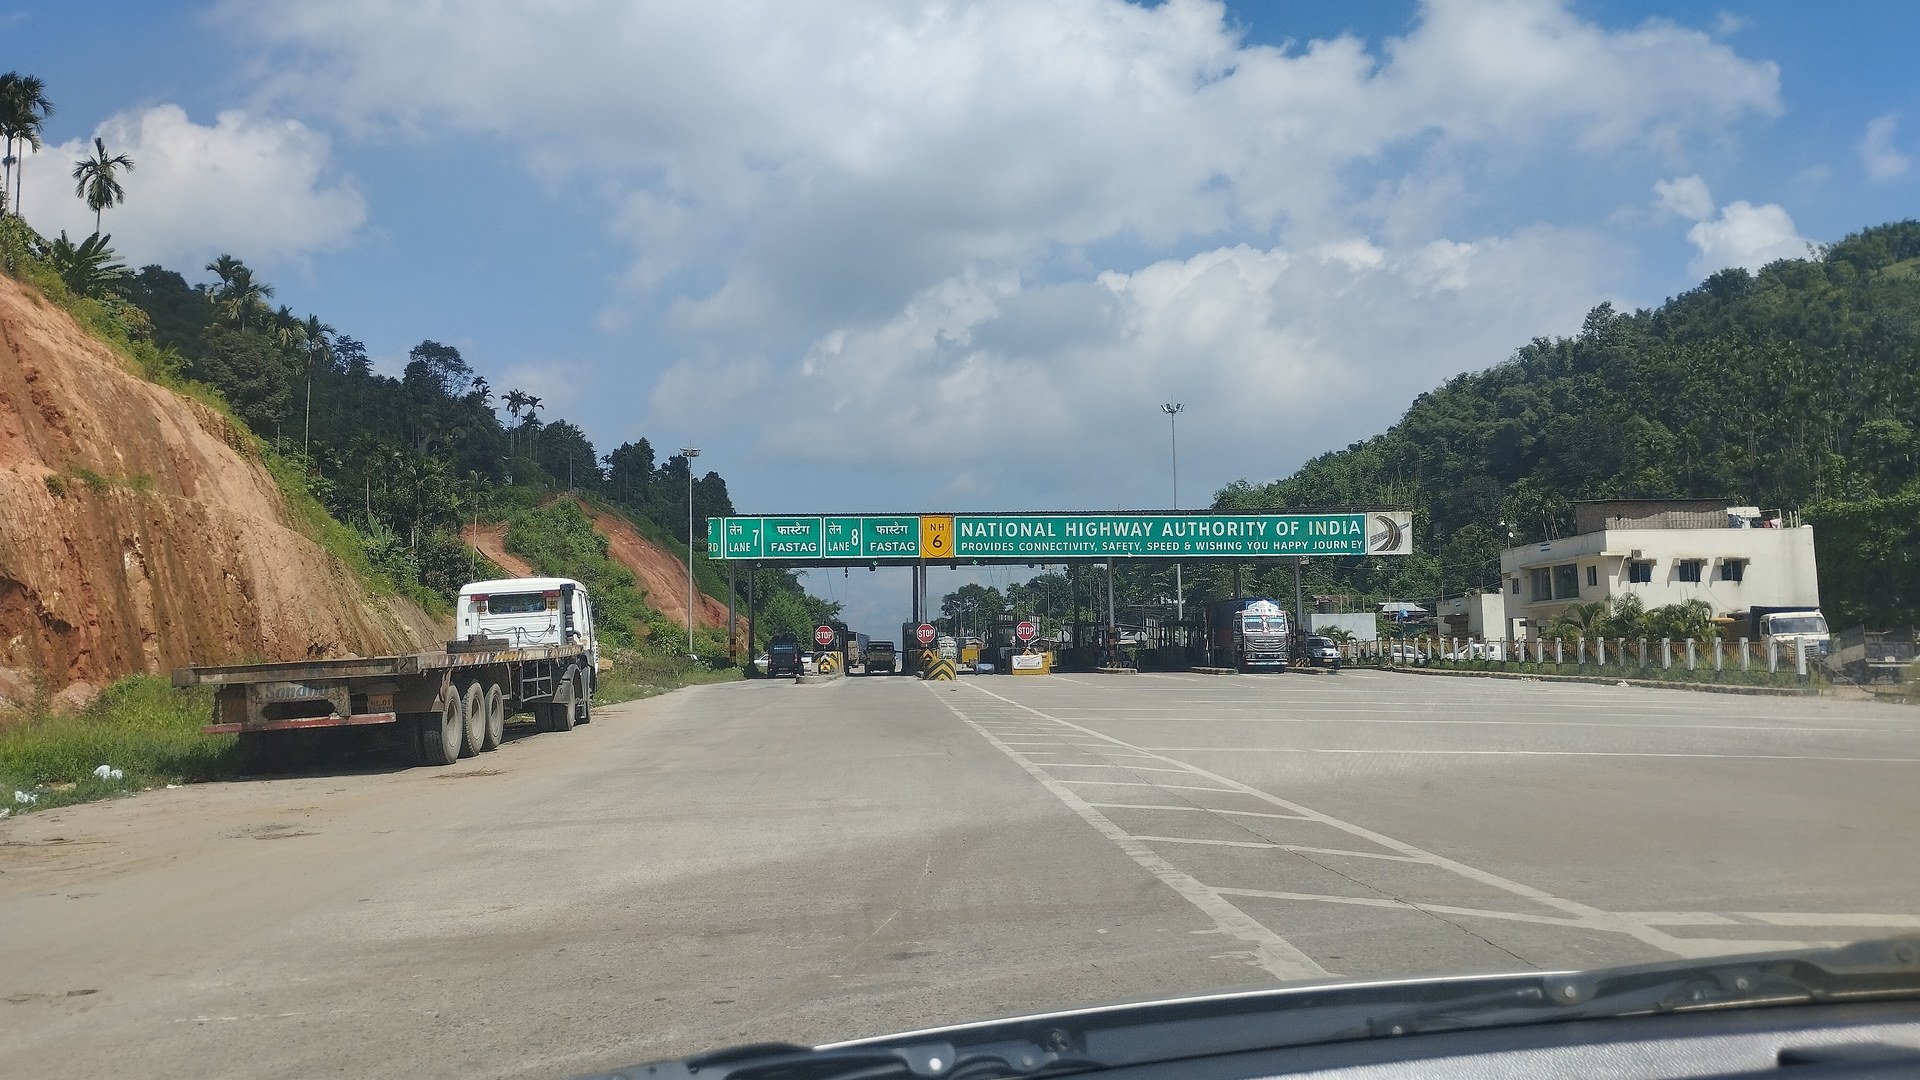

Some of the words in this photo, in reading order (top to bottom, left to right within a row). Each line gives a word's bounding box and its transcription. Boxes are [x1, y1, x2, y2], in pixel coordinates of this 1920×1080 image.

[729, 523, 742, 535] लेन
[777, 522, 810, 535] फास्टैग
[828, 522, 841, 534] लेन
[876, 522, 908, 534] फास्टैग
[962, 523, 1056, 537] NATIONAL
[1066, 522, 1153, 536] HIGHWAY
[1162, 522, 1267, 536] AUTHORITY
[1276, 521, 1299, 535] OF
[1309, 521, 1360, 535] INDIA
[753, 530, 759, 546] 7
[852, 529, 858, 545] 8
[932, 534, 942, 548] 6
[730, 543, 750, 552] LANE
[772, 543, 816, 551] FASTAG
[829, 542, 849, 551] LANE
[871, 542, 915, 551] FASTAG
[962, 543, 1013, 551] PROVIDES
[1019, 542, 1097, 551] CONNECTIVITY,
[1103, 542, 1142, 551] SAFETY,
[1147, 542, 1179, 551] SPEED
[1185, 542, 1191, 551] &
[1196, 542, 1242, 551] WISHING
[1247, 541, 1268, 551] YOU
[1274, 542, 1308, 550] HAPPY
[816, 630, 832, 640] STOP
[918, 629, 934, 638] STOP
[1018, 627, 1034, 636] STOP
